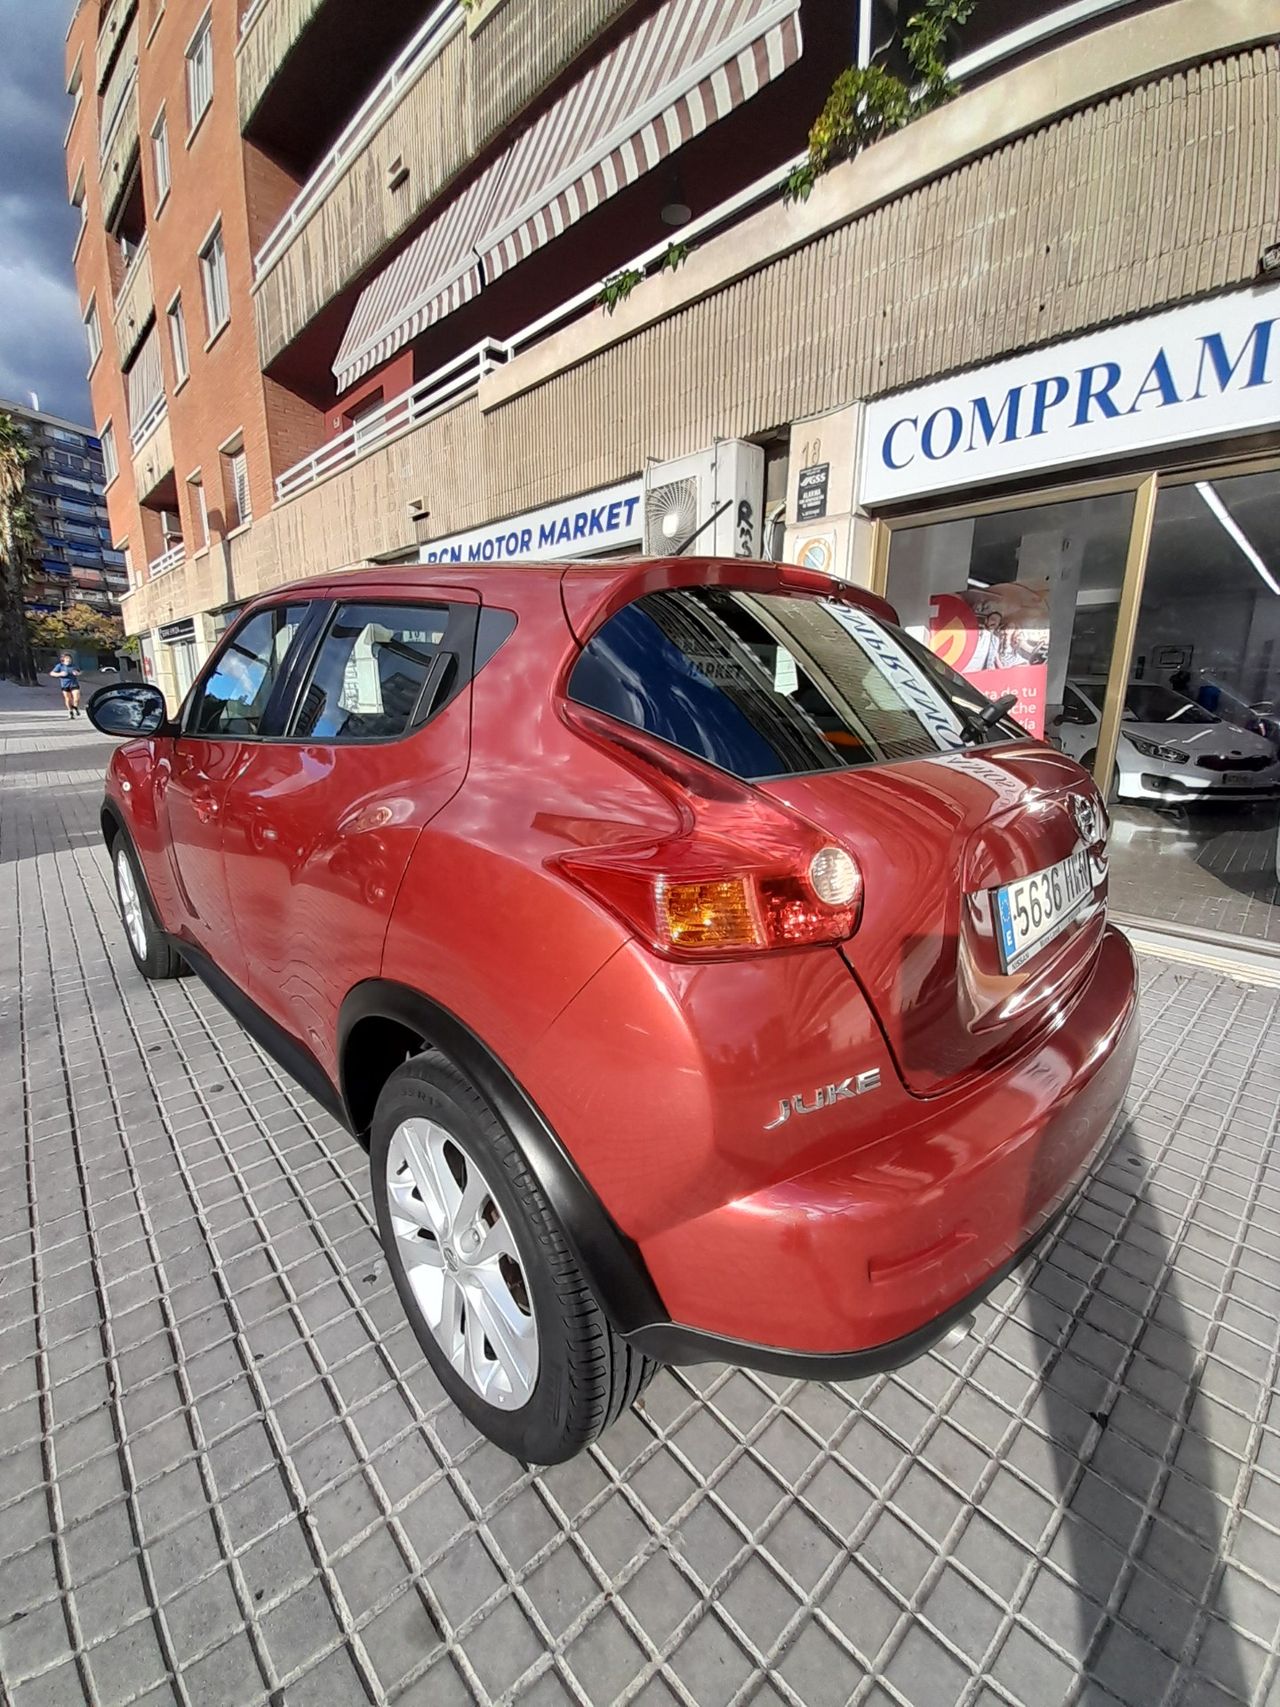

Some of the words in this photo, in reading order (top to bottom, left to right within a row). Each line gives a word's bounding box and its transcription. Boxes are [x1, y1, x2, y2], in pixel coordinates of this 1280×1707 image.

[881, 317, 1280, 470] COMPRAM
[802, 438, 821, 468] 18
[469, 528, 532, 561] MOTOR
[538, 496, 640, 549] MARKET
[1008, 702, 1036, 715] che
[1022, 687, 1037, 697] tu
[1006, 930, 1012, 946] E
[1014, 866, 1063, 936] 5636
[763, 1067, 881, 1130] JUKE
